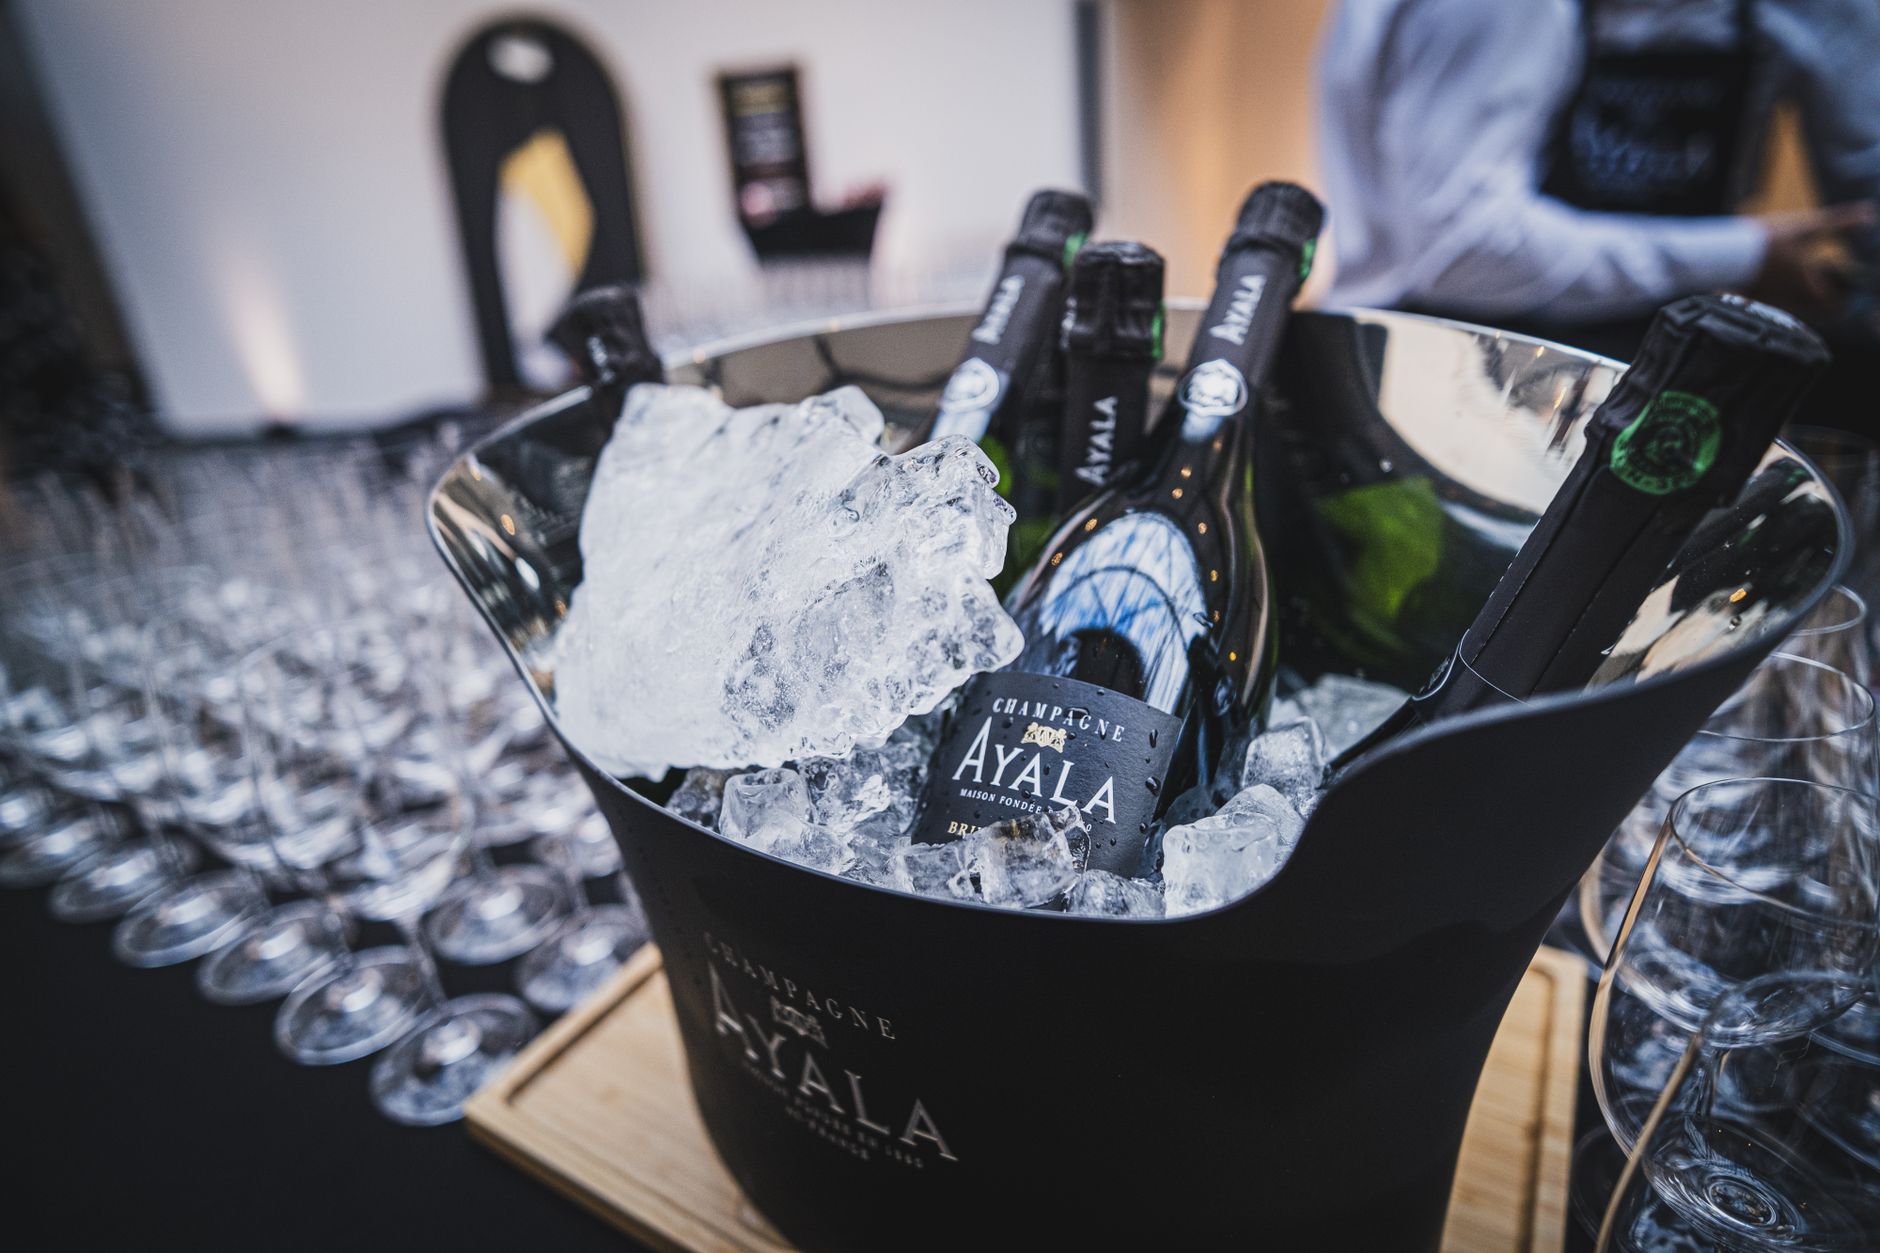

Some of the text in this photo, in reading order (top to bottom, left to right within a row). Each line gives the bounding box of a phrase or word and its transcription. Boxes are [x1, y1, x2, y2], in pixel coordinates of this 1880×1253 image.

[1210, 275, 1266, 345] AYALA
[1075, 396, 1118, 485] AYALA
[992, 697, 1125, 742] CHAMPAGNE
[952, 716, 1116, 824] AYALA
[959, 788, 996, 802] MAISON
[707, 961, 959, 1162] AYALA
